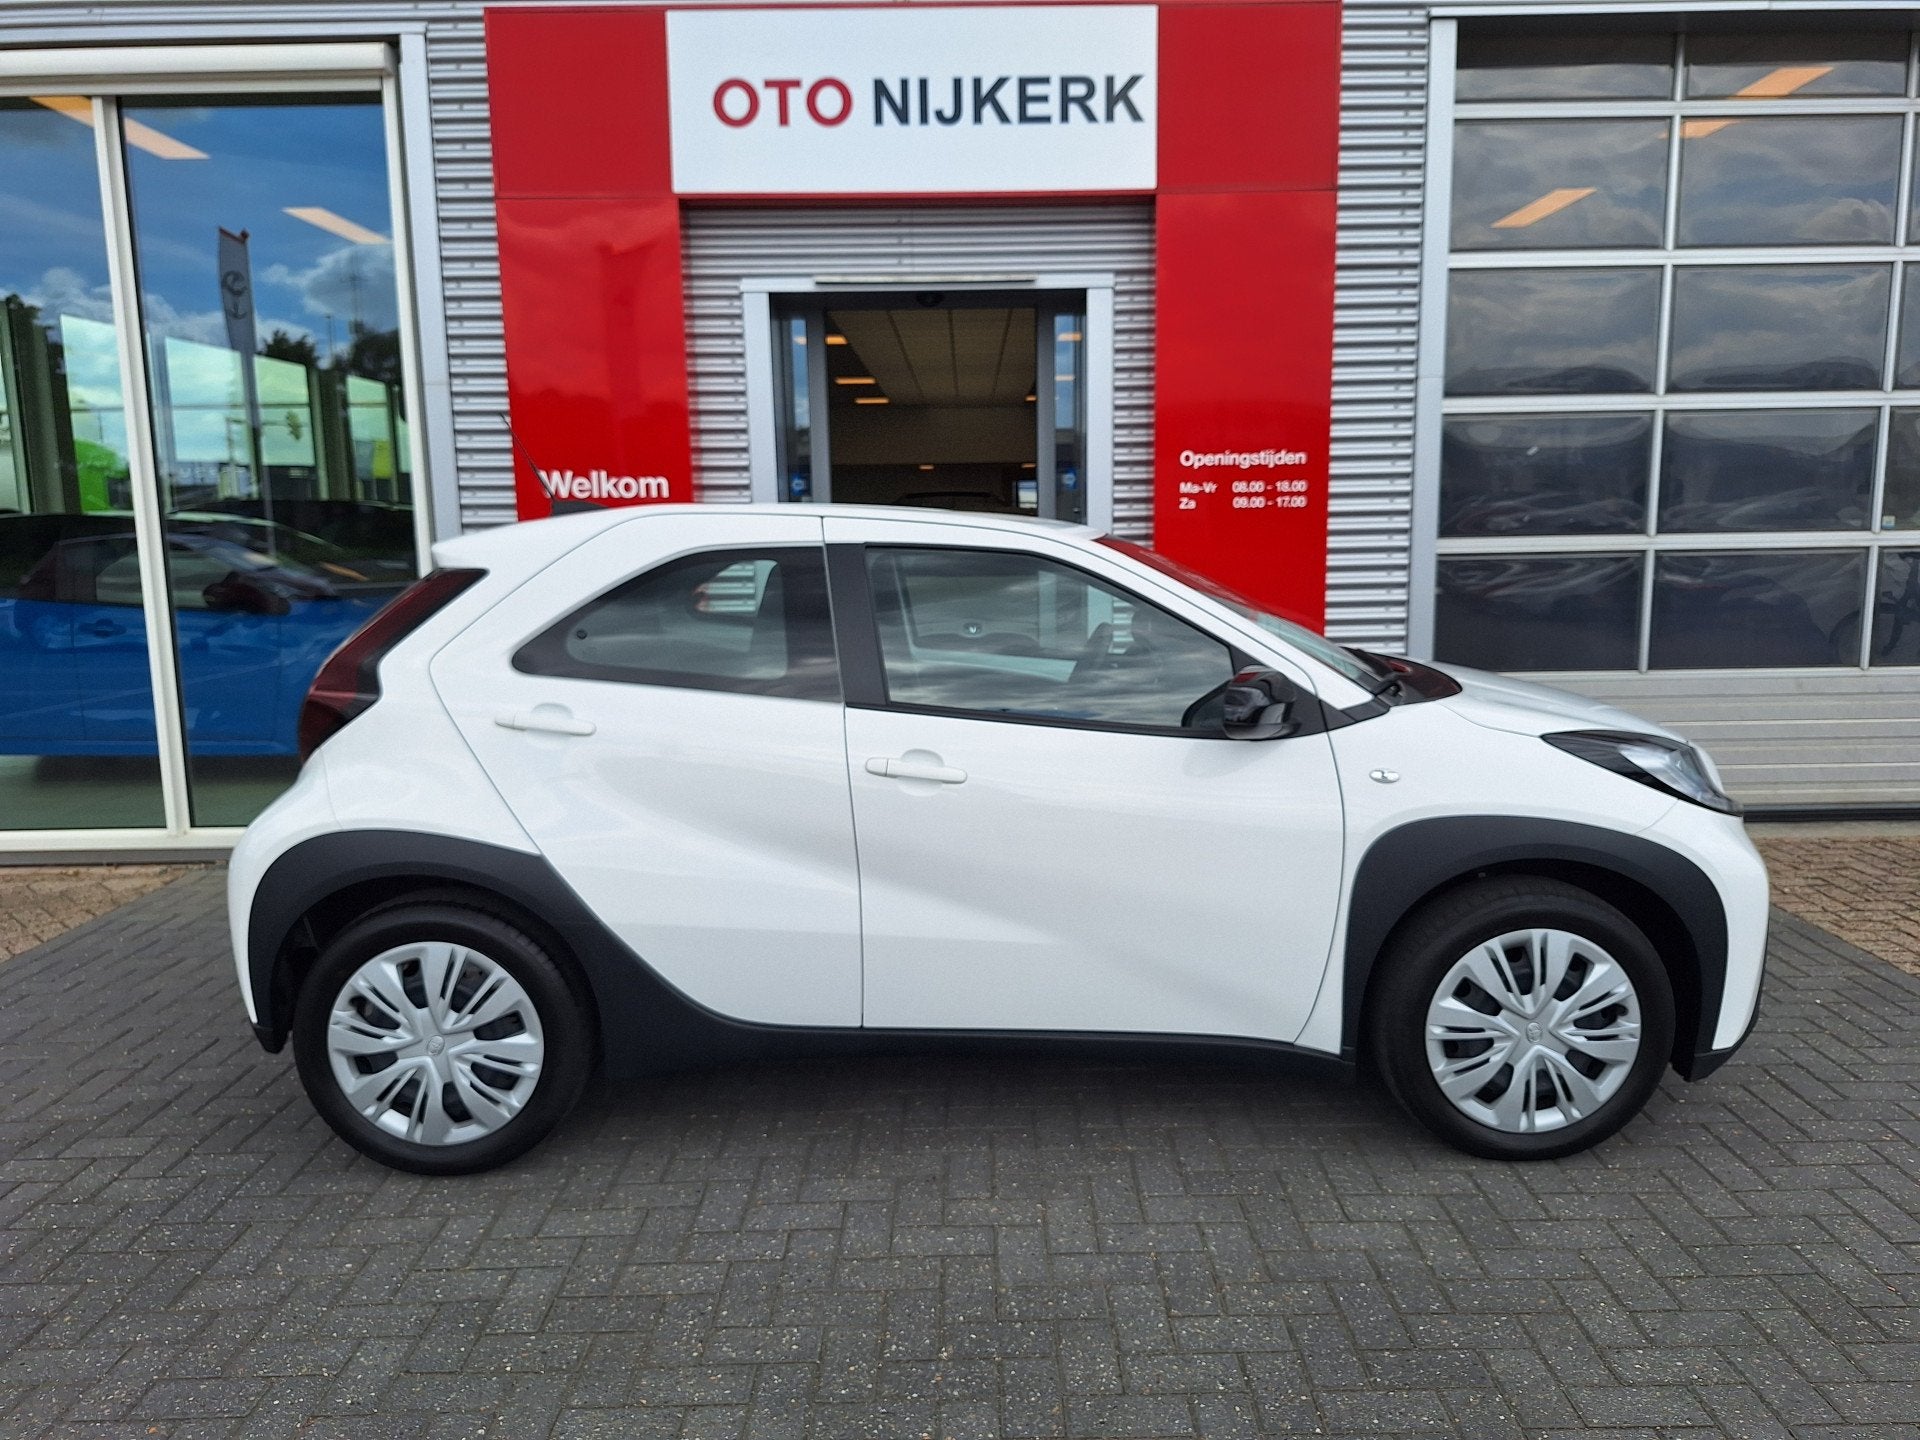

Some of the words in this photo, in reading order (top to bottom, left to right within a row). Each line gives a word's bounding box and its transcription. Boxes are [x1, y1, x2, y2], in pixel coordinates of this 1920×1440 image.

[713, 77, 853, 127] OTO
[873, 75, 1144, 126] NIJKERK
[1179, 449, 1307, 468] Openingstijden
[538, 469, 670, 499] Welkom
[1179, 482, 1218, 494] Ma-Vr
[1179, 497, 1197, 510] Za
